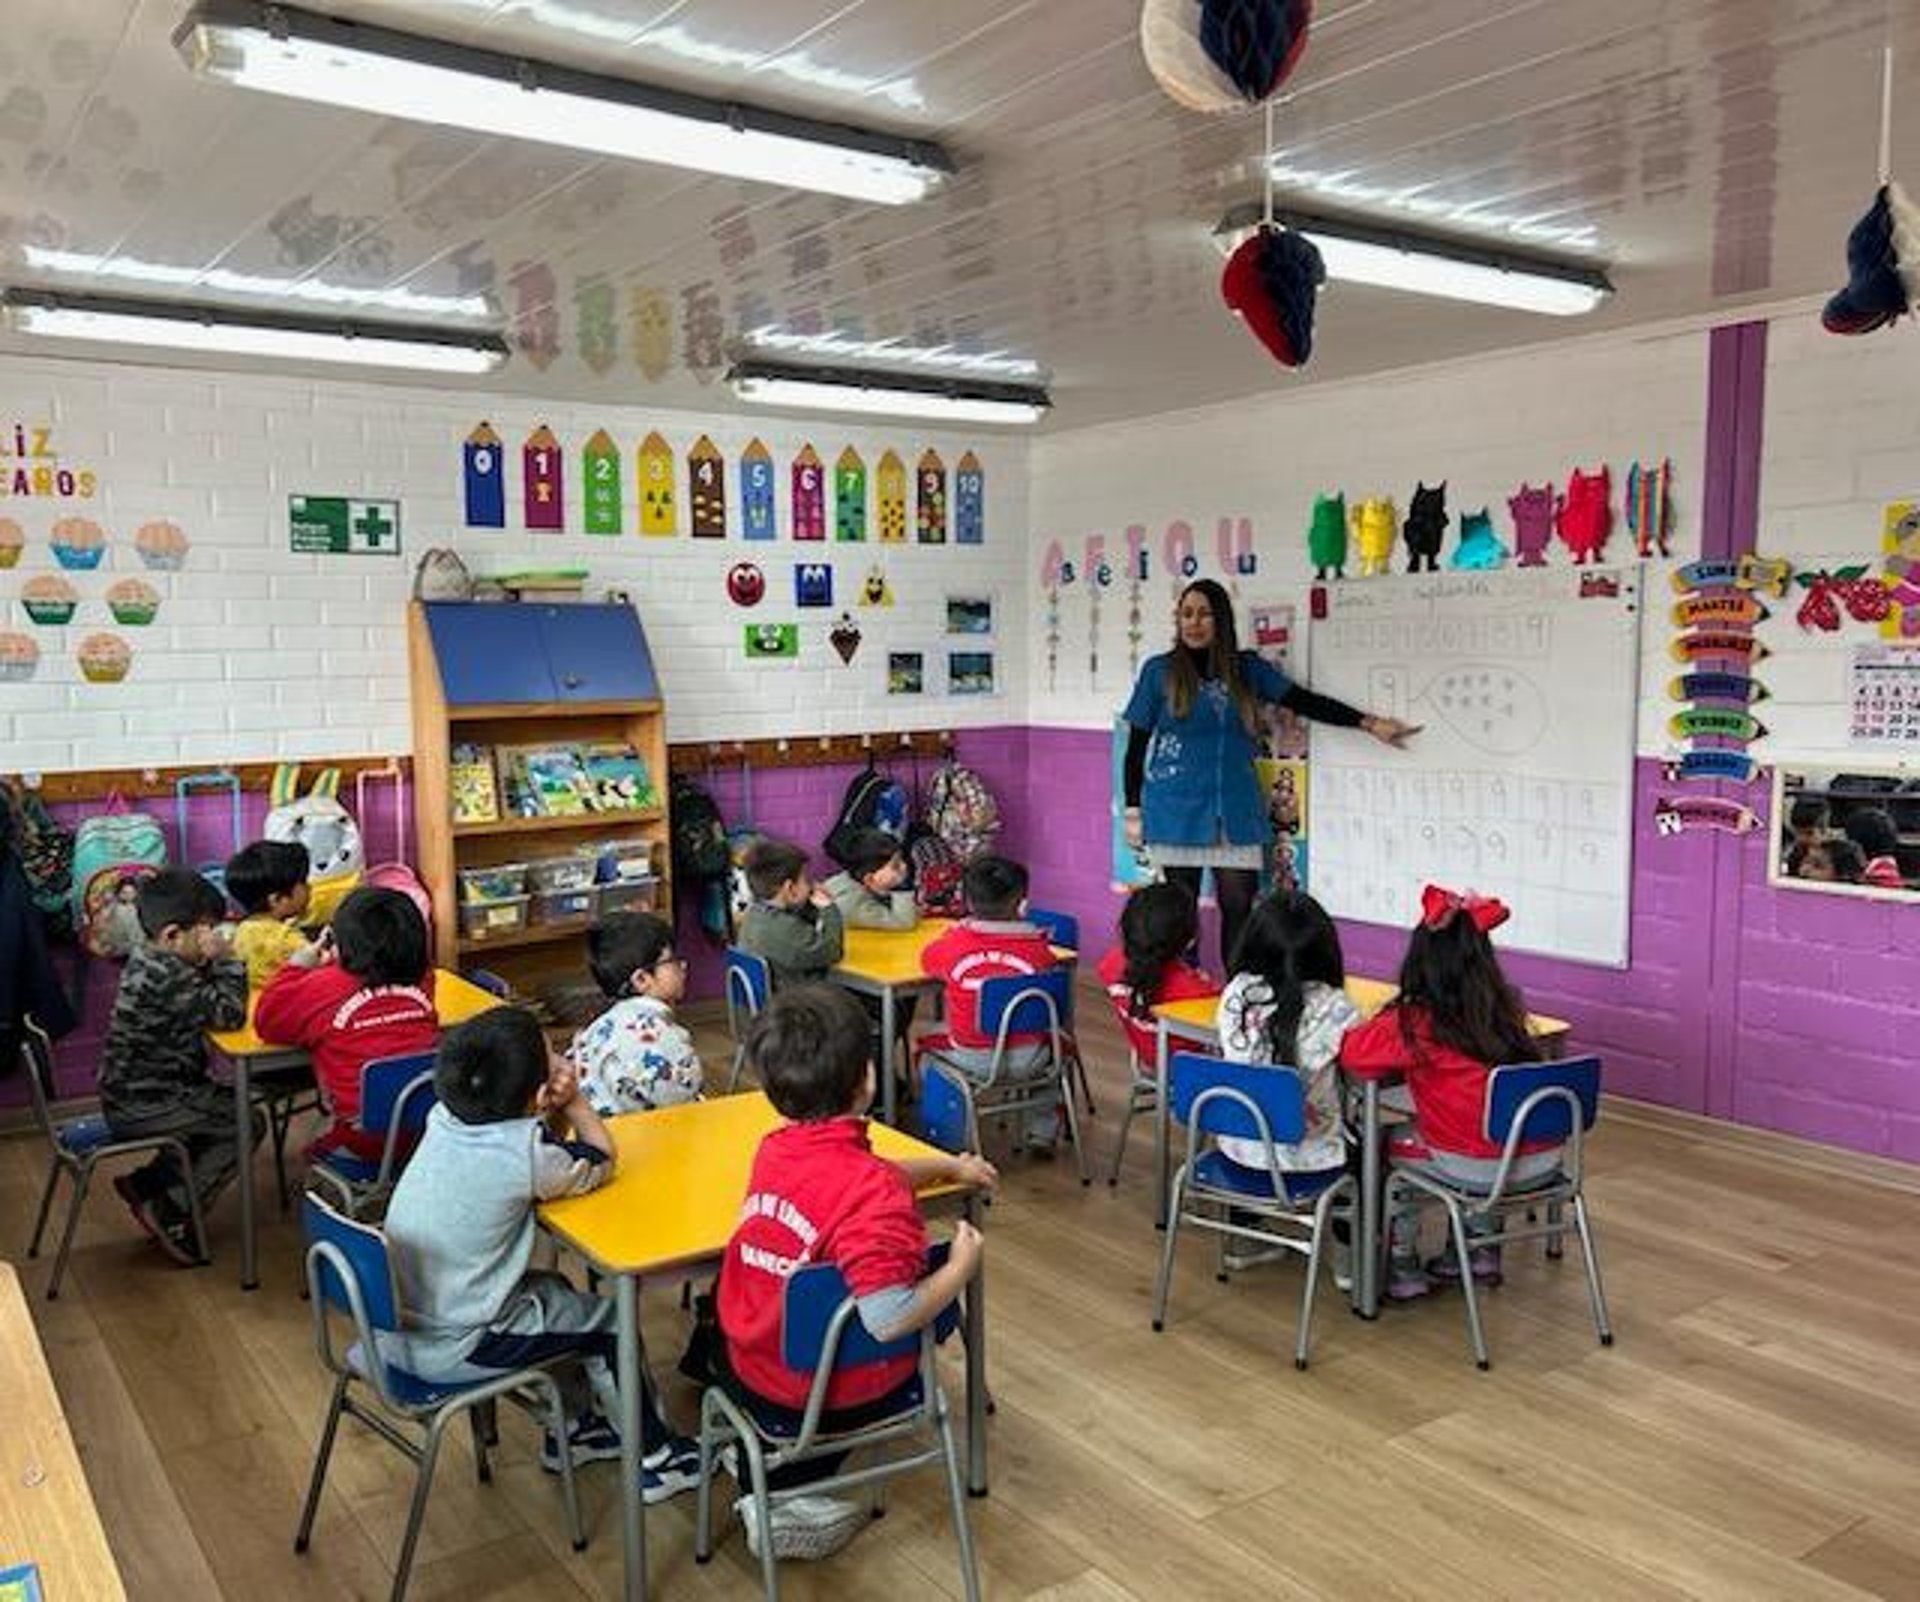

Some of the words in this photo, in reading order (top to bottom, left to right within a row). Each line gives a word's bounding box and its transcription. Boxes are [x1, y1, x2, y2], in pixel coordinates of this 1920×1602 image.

[474, 449, 492, 475] 0
[535, 452, 548, 476] 1
[596, 458, 610, 480] 2
[650, 460, 664, 480] 3
[699, 461, 713, 485] 4
[752, 464, 766, 488] 5
[801, 469, 816, 491] 6
[845, 472, 858, 491] 7
[925, 473, 939, 493] 9
[959, 476, 980, 493] 10
[1180, 555, 1198, 577] o
[1238, 554, 1256, 575] u
